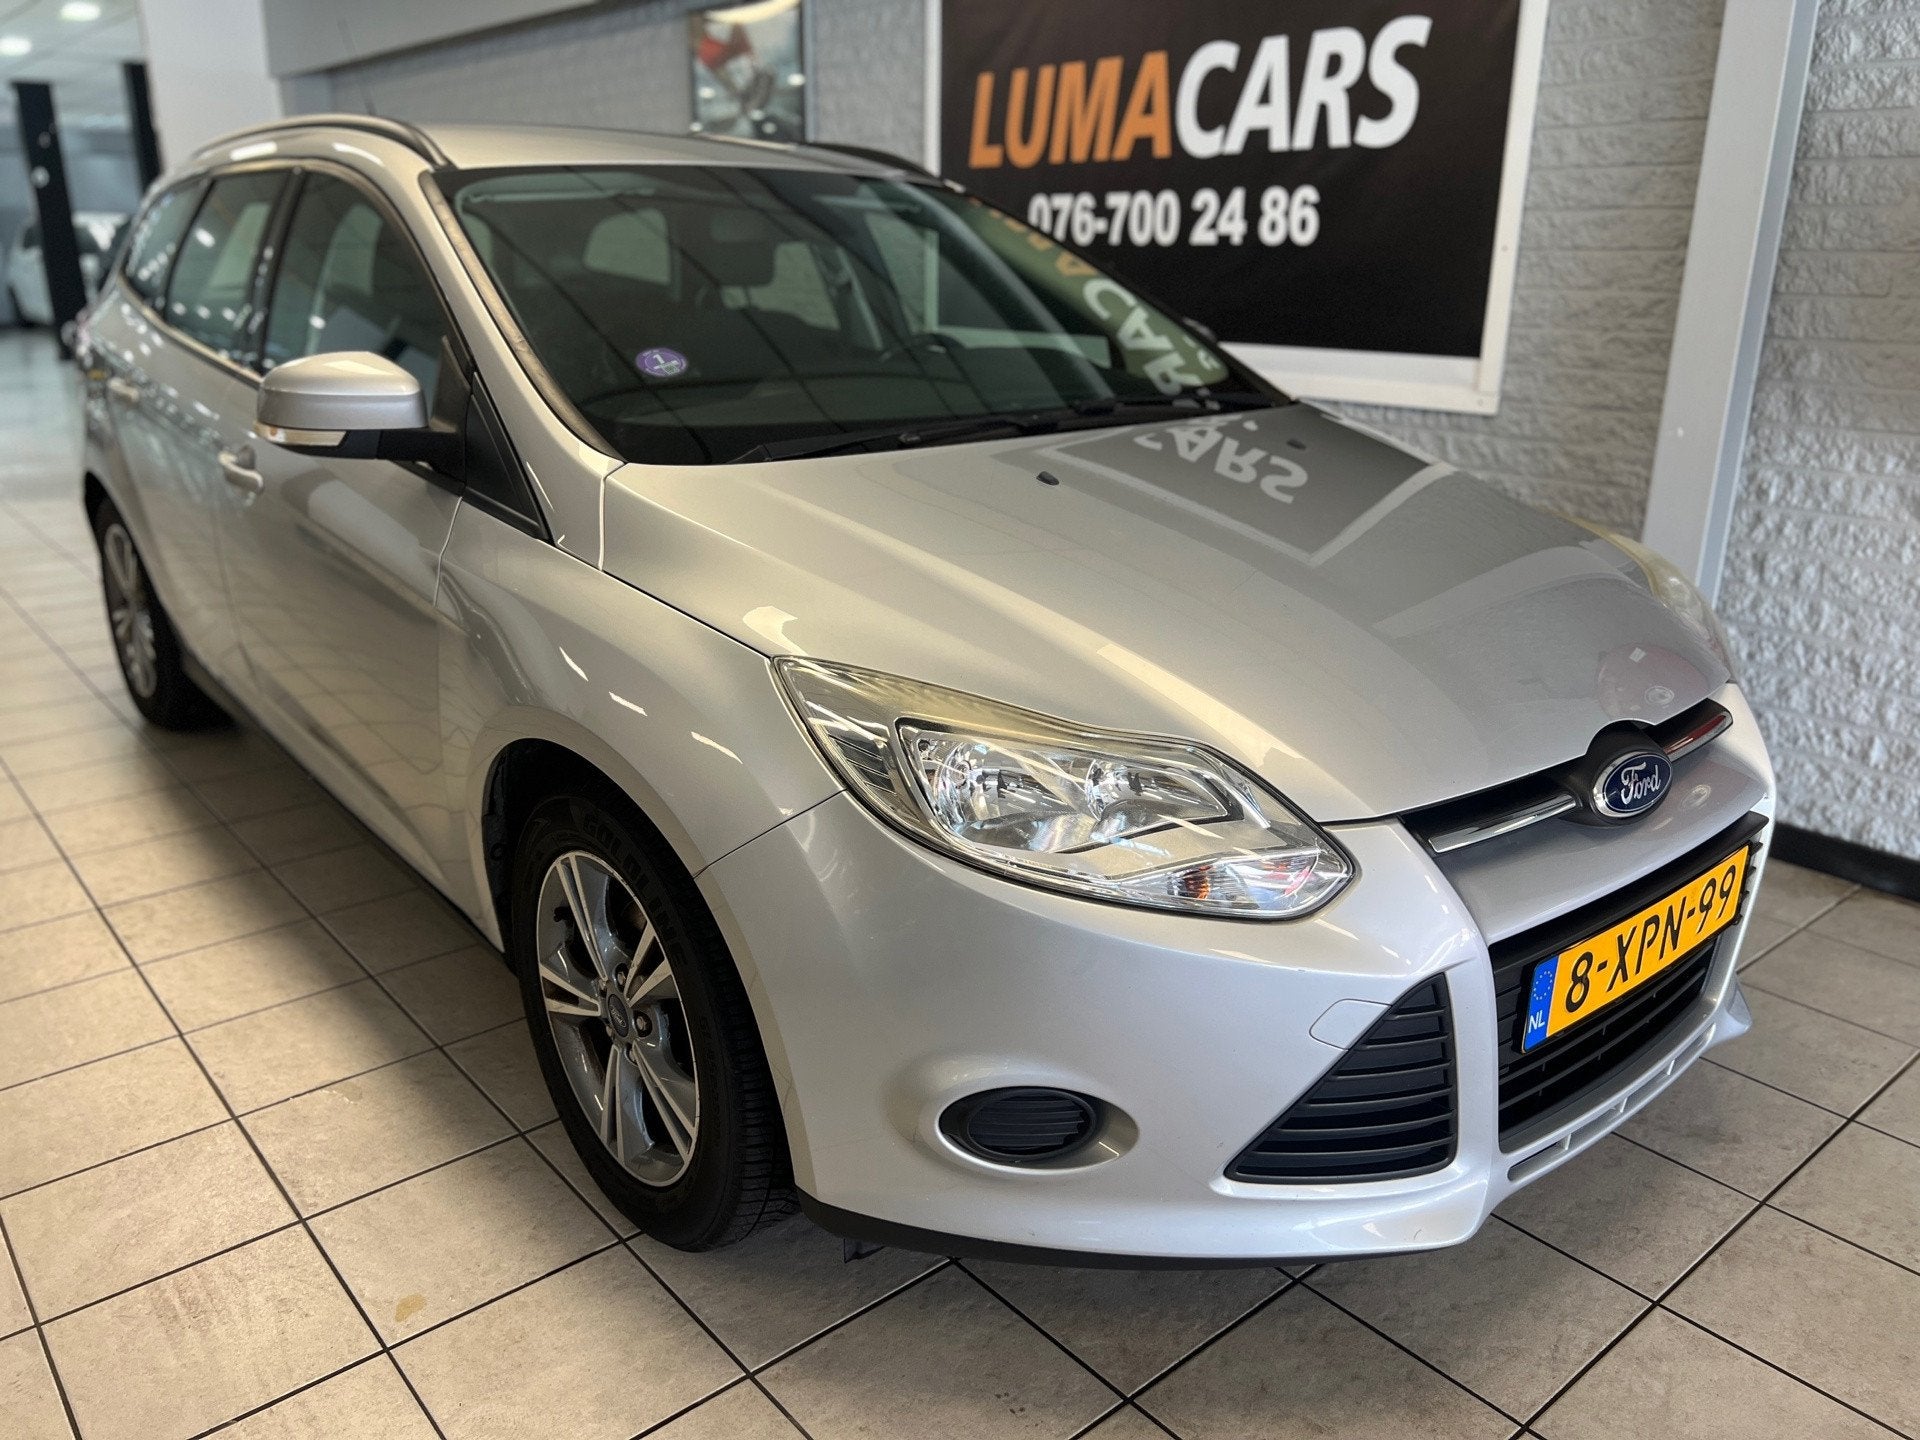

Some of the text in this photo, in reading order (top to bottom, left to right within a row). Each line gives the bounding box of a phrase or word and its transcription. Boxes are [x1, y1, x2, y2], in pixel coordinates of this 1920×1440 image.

[969, 15, 1433, 168] LUMACARS
[1027, 185, 1320, 247] 076-700 24 86
[1620, 761, 1662, 805] Ford
[1565, 864, 1736, 1013] 8-XPN-99
[1527, 1009, 1545, 1034] NL
